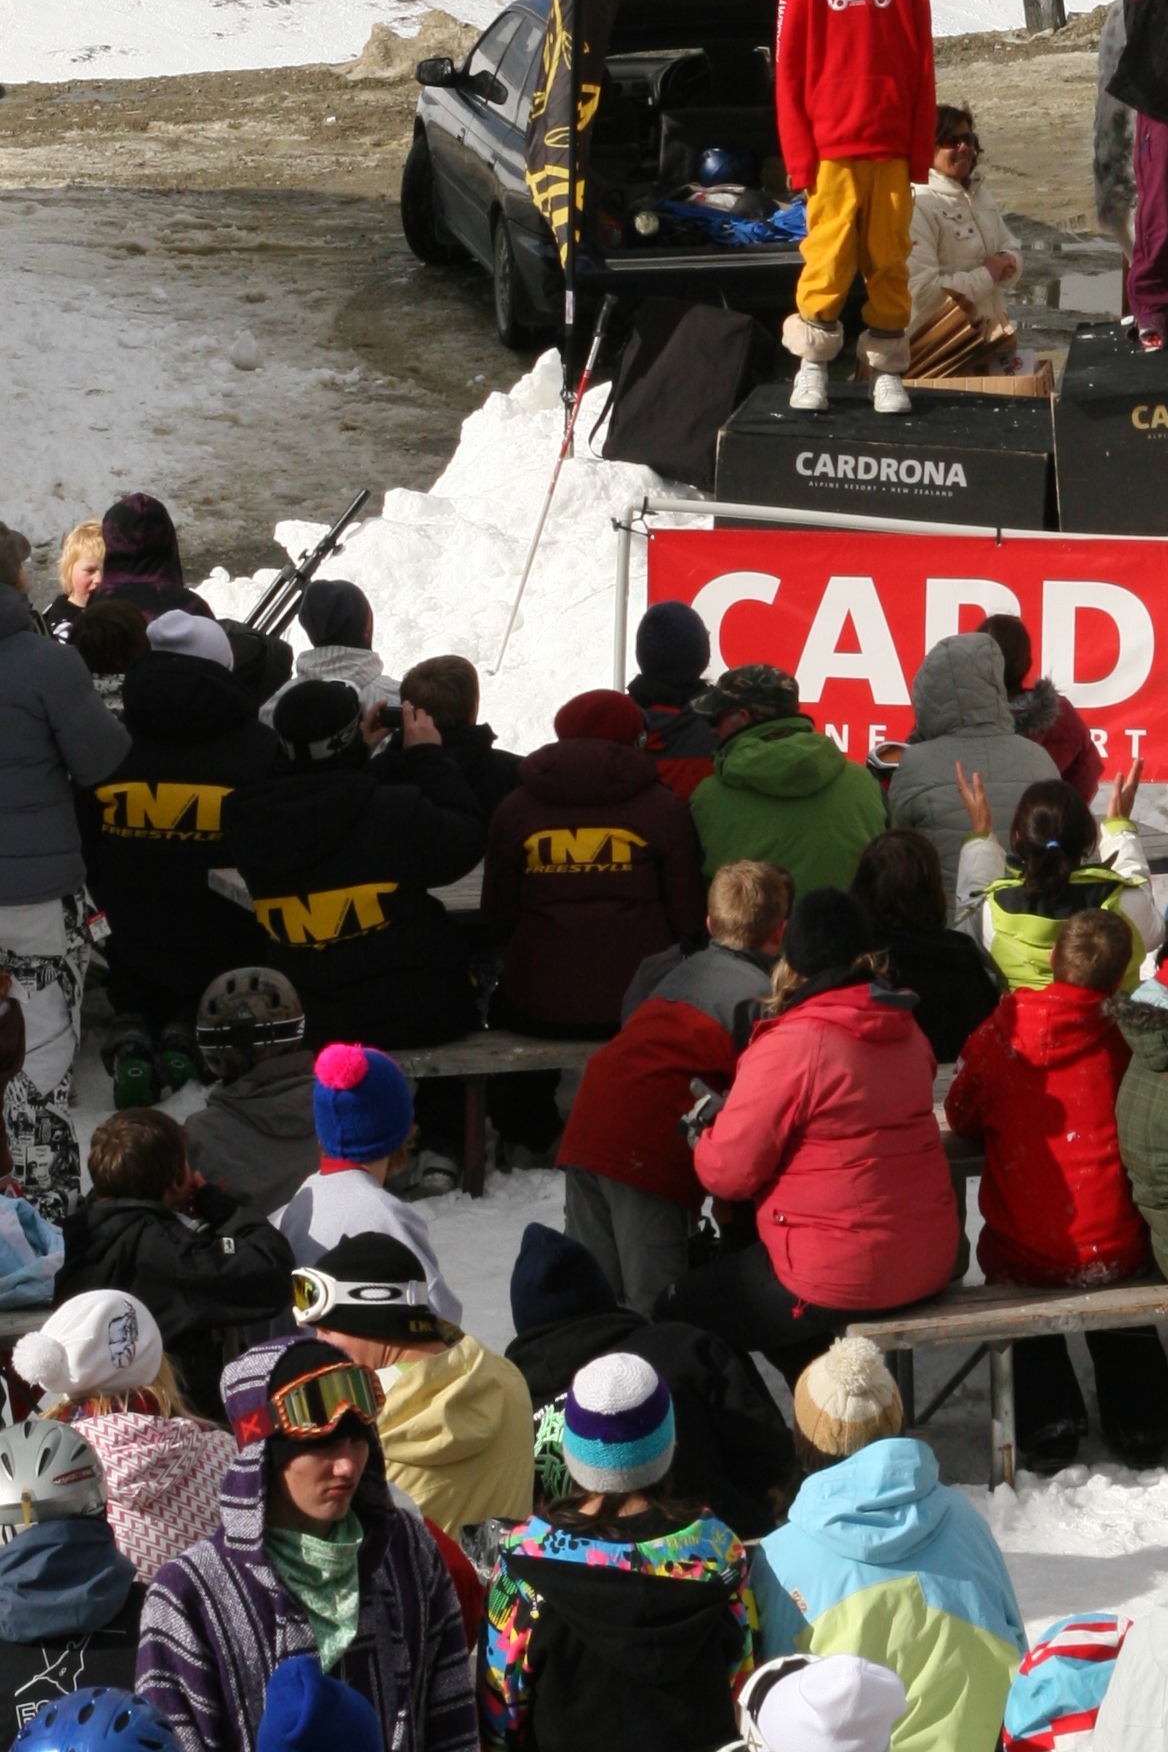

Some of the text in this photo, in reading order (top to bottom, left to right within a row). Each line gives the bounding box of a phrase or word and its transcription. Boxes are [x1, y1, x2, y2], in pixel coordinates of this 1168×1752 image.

[796, 452, 968, 487] CARDRONA
[809, 481, 839, 489] ALPINE
[844, 484, 877, 492] RESORT
[914, 488, 953, 497] ZEALAND
[102, 824, 224, 841] FREESTYLE
[525, 864, 633, 874] FREESTYLE
